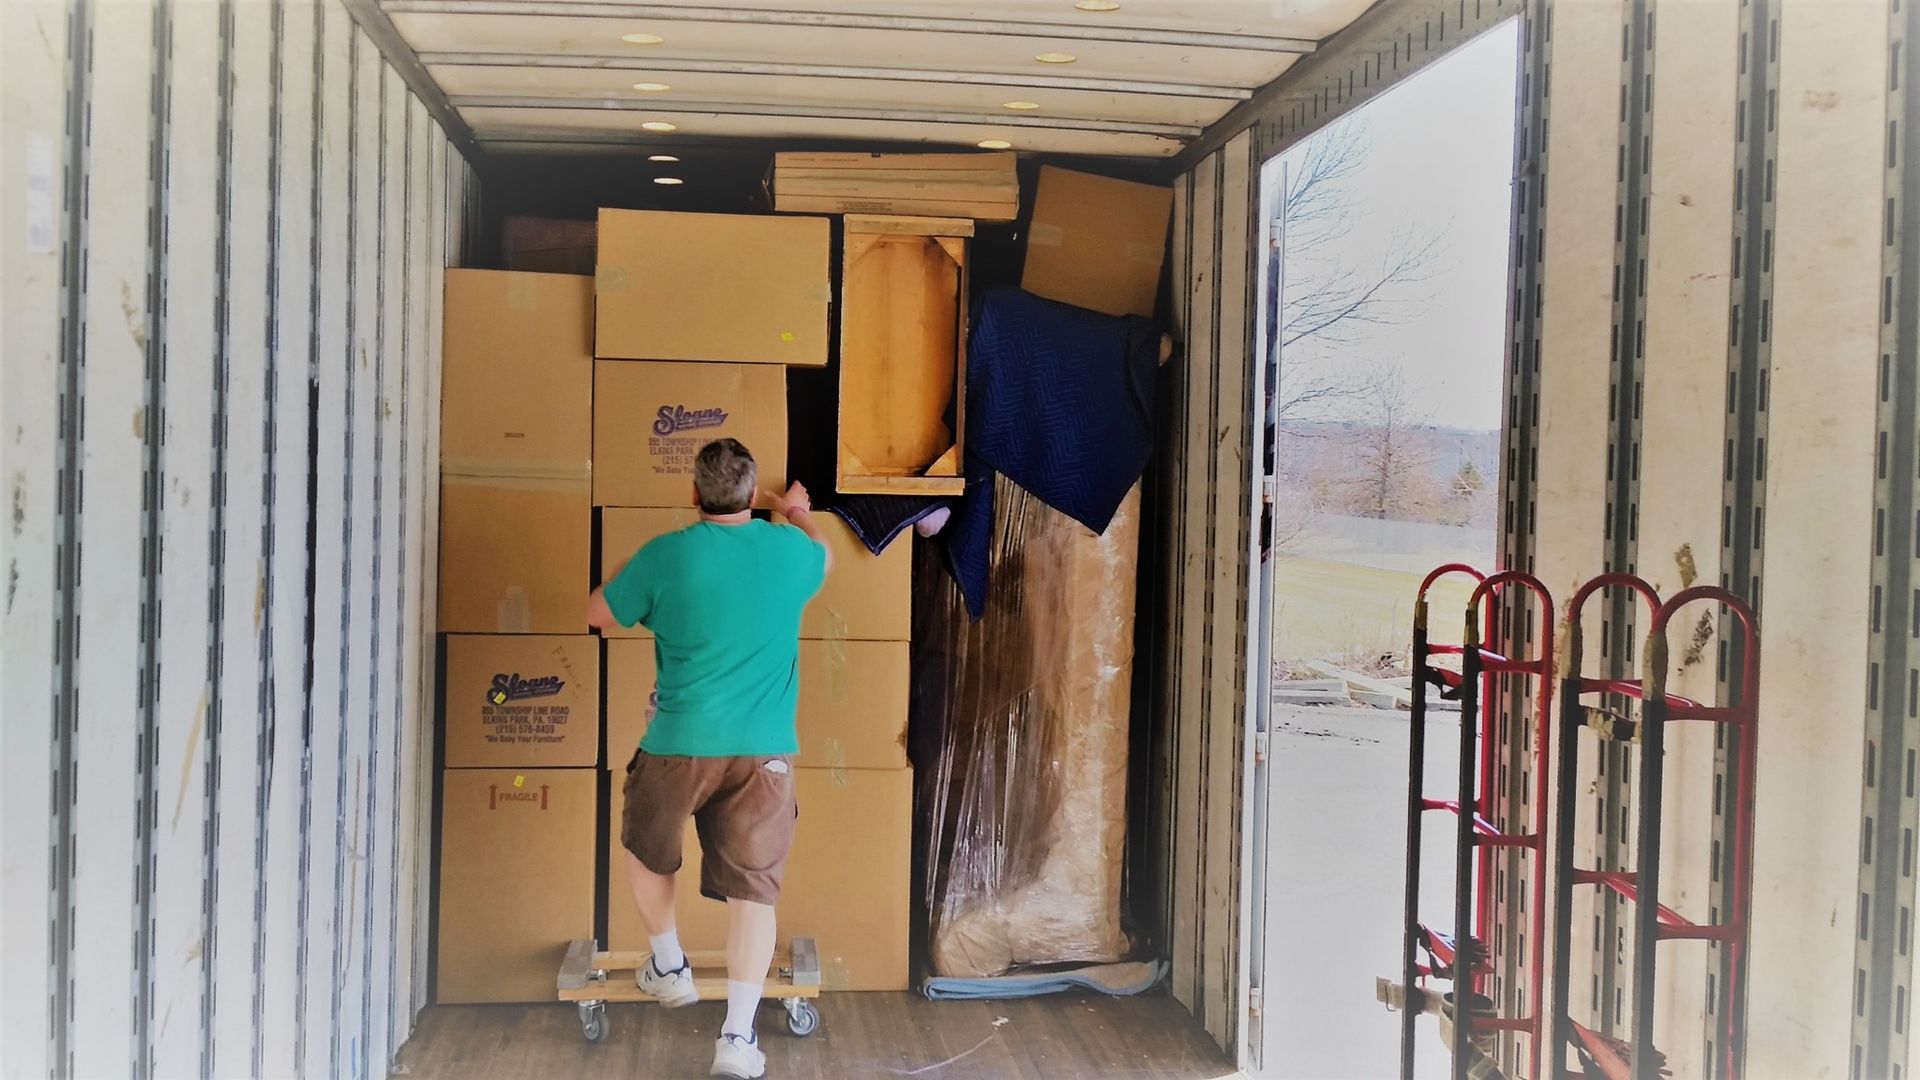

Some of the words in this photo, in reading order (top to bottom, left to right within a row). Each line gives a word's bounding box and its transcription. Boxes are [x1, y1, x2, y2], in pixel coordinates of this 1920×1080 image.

[652, 404, 728, 436] Sloane
[649, 446, 674, 455] ELKINS
[662, 456, 683, 465] (215)
[486, 672, 566, 706] Sloane
[496, 706, 532, 715] TOWNSHIP
[533, 706, 548, 715] LINE
[550, 706, 570, 715] ROAD
[482, 715, 508, 724] ELKINS
[496, 725, 516, 734] (215)
[500, 735, 515, 744] Baby
[517, 735, 532, 743] Your
[499, 791, 539, 802] FRAGILE
